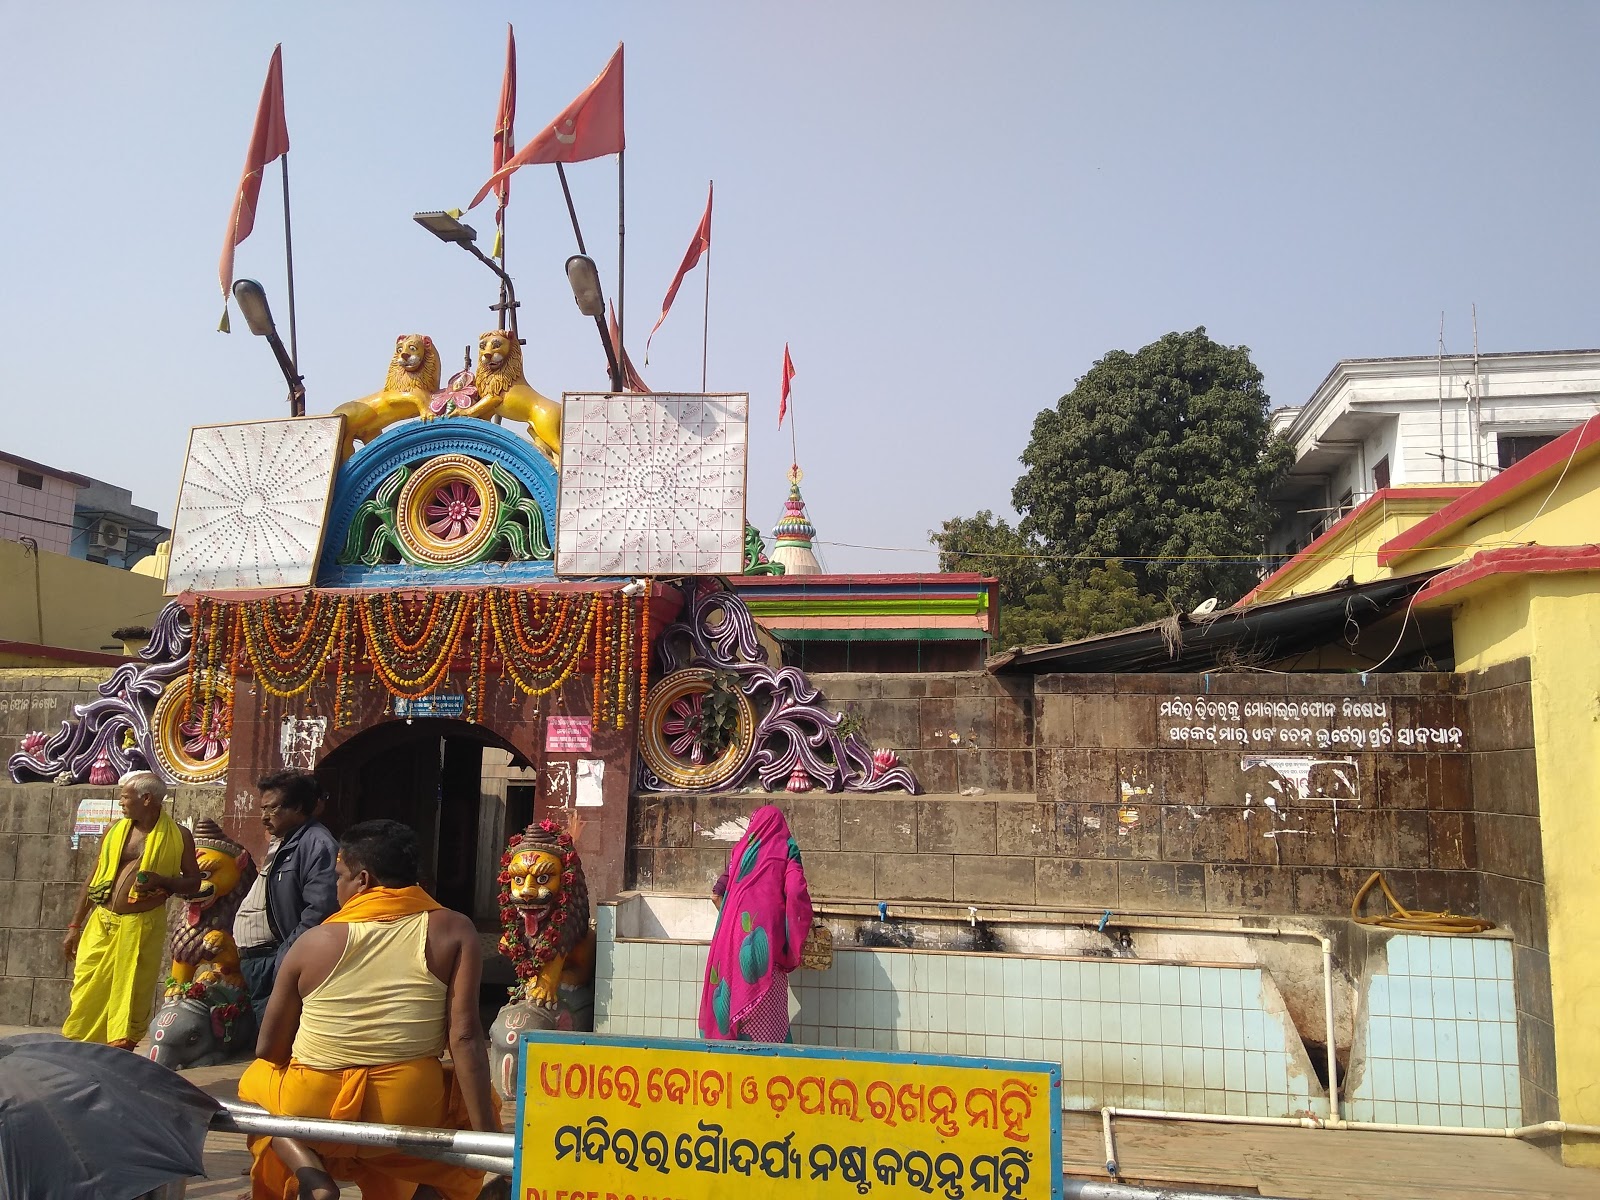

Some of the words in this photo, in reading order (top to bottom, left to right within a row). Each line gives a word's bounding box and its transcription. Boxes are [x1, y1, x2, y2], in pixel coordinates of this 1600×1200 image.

[1342, 698, 1386, 718] ନିଷେଧ
[1252, 727, 1277, 741] ଏବଂ
[540, 1061, 642, 1109] ଏଠାରେ
[647, 1067, 732, 1109] ଜୋତା
[740, 1075, 759, 1104] ଓ
[866, 1080, 960, 1137] ରଖନ୍ତୁ
[965, 1078, 1038, 1143] ନାହିଁ
[808, 1144, 872, 1194] ନଷ୍ଟ
[873, 1147, 964, 1200] କରନ୍ତୁ
[970, 1146, 1035, 1200] ନାହିଁ
